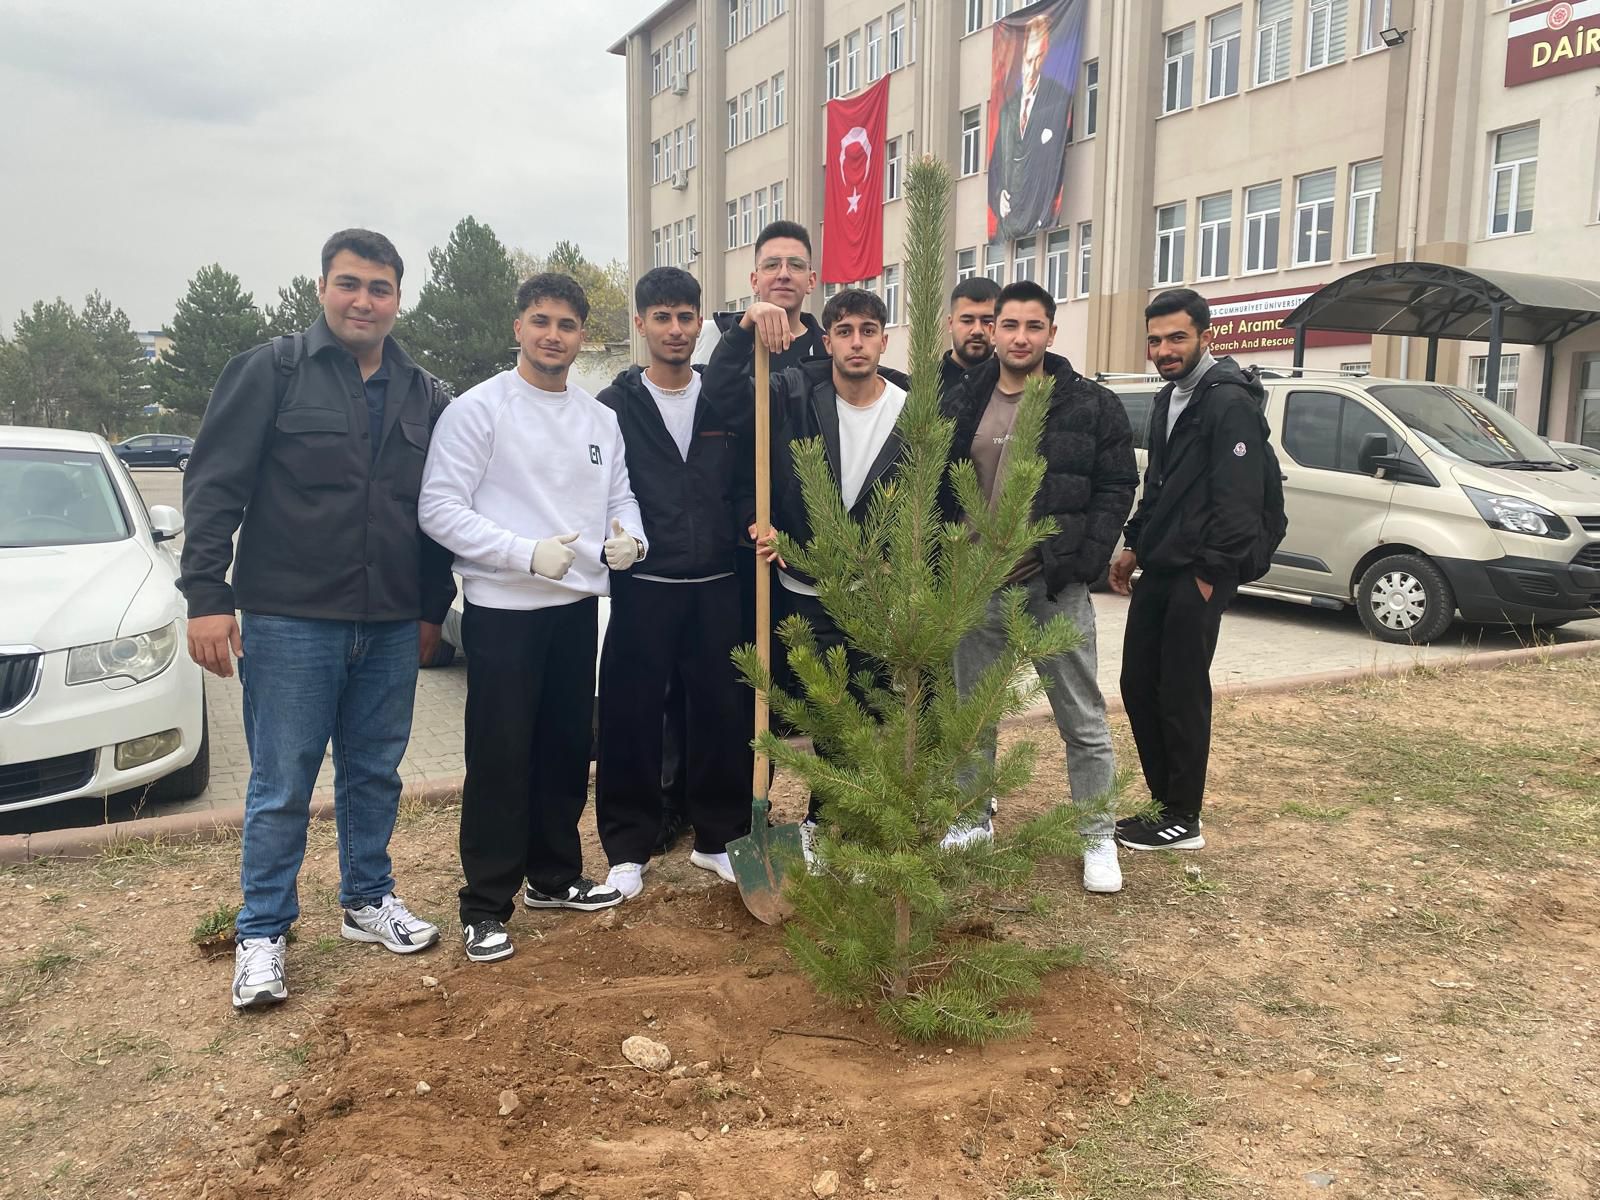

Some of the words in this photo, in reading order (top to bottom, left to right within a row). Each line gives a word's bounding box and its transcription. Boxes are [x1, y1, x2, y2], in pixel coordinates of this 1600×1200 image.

[1218, 303, 1263, 315] CUMHURİYET
[1210, 340, 1239, 351] Search
[1241, 337, 1260, 349] And
[1261, 337, 1295, 347] Rescue
